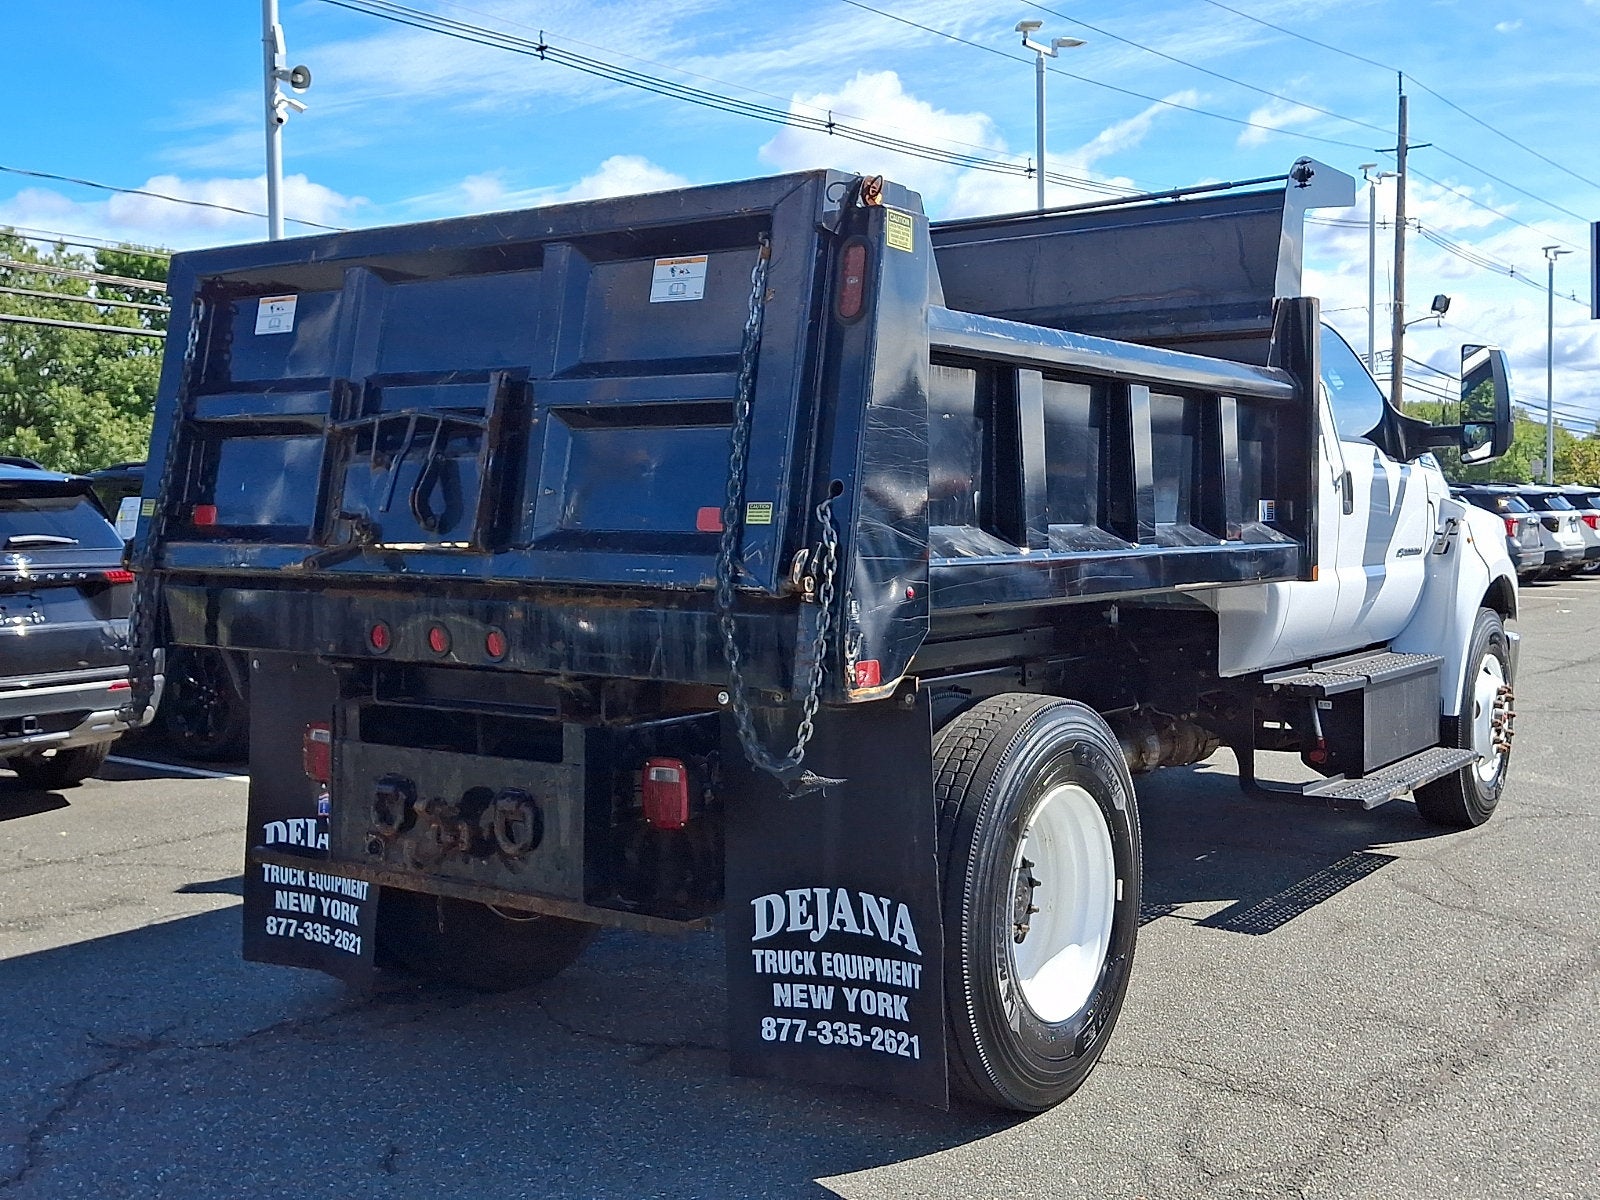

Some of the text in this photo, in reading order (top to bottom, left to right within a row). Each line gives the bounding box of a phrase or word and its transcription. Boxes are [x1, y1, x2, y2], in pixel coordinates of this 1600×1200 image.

[889, 213, 910, 226] CAUTION
[262, 863, 369, 901] TRUCK EQUIPMENT
[275, 889, 360, 927] NEW YORK
[750, 887, 923, 956] DEJANA
[265, 915, 362, 956] 877-335-2621
[751, 949, 923, 990] TRUCK EQUIPMENT
[772, 982, 910, 1023] NEW YORK
[761, 1016, 921, 1060] 877-335-2621
